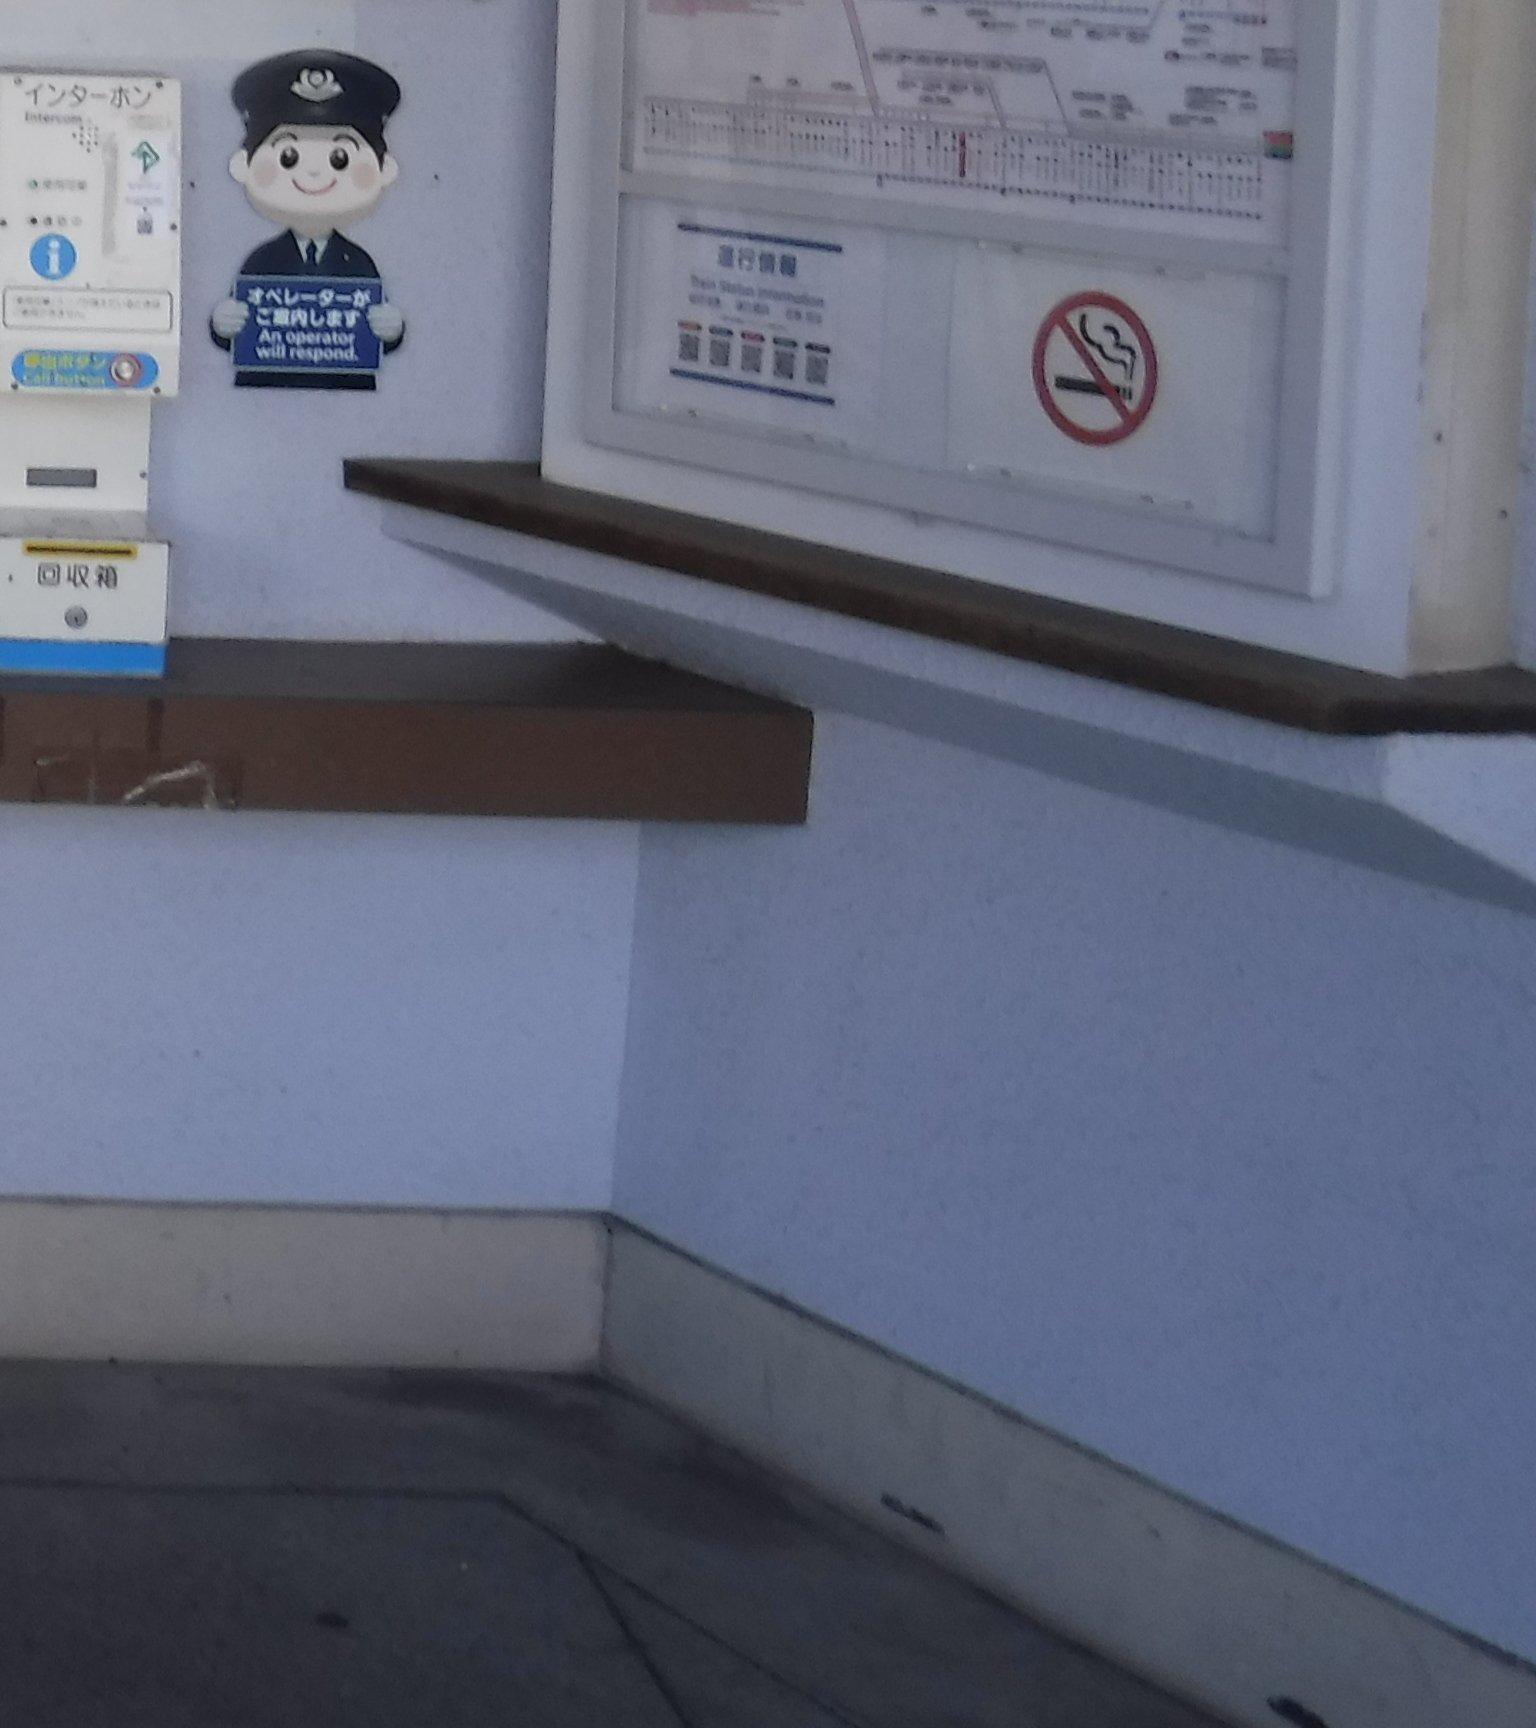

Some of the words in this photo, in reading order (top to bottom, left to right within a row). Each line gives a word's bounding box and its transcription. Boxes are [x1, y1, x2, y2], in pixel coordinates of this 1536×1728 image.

[25, 83, 151, 109] インターホン
[25, 111, 83, 123] Intercom
[247, 287, 371, 308] オペレーターが
[255, 308, 360, 328] ご案内します
[259, 330, 282, 343] An
[286, 331, 356, 350] operator
[256, 345, 286, 360] will
[290, 345, 359, 364] respond.
[37, 562, 118, 589] 回収箱
